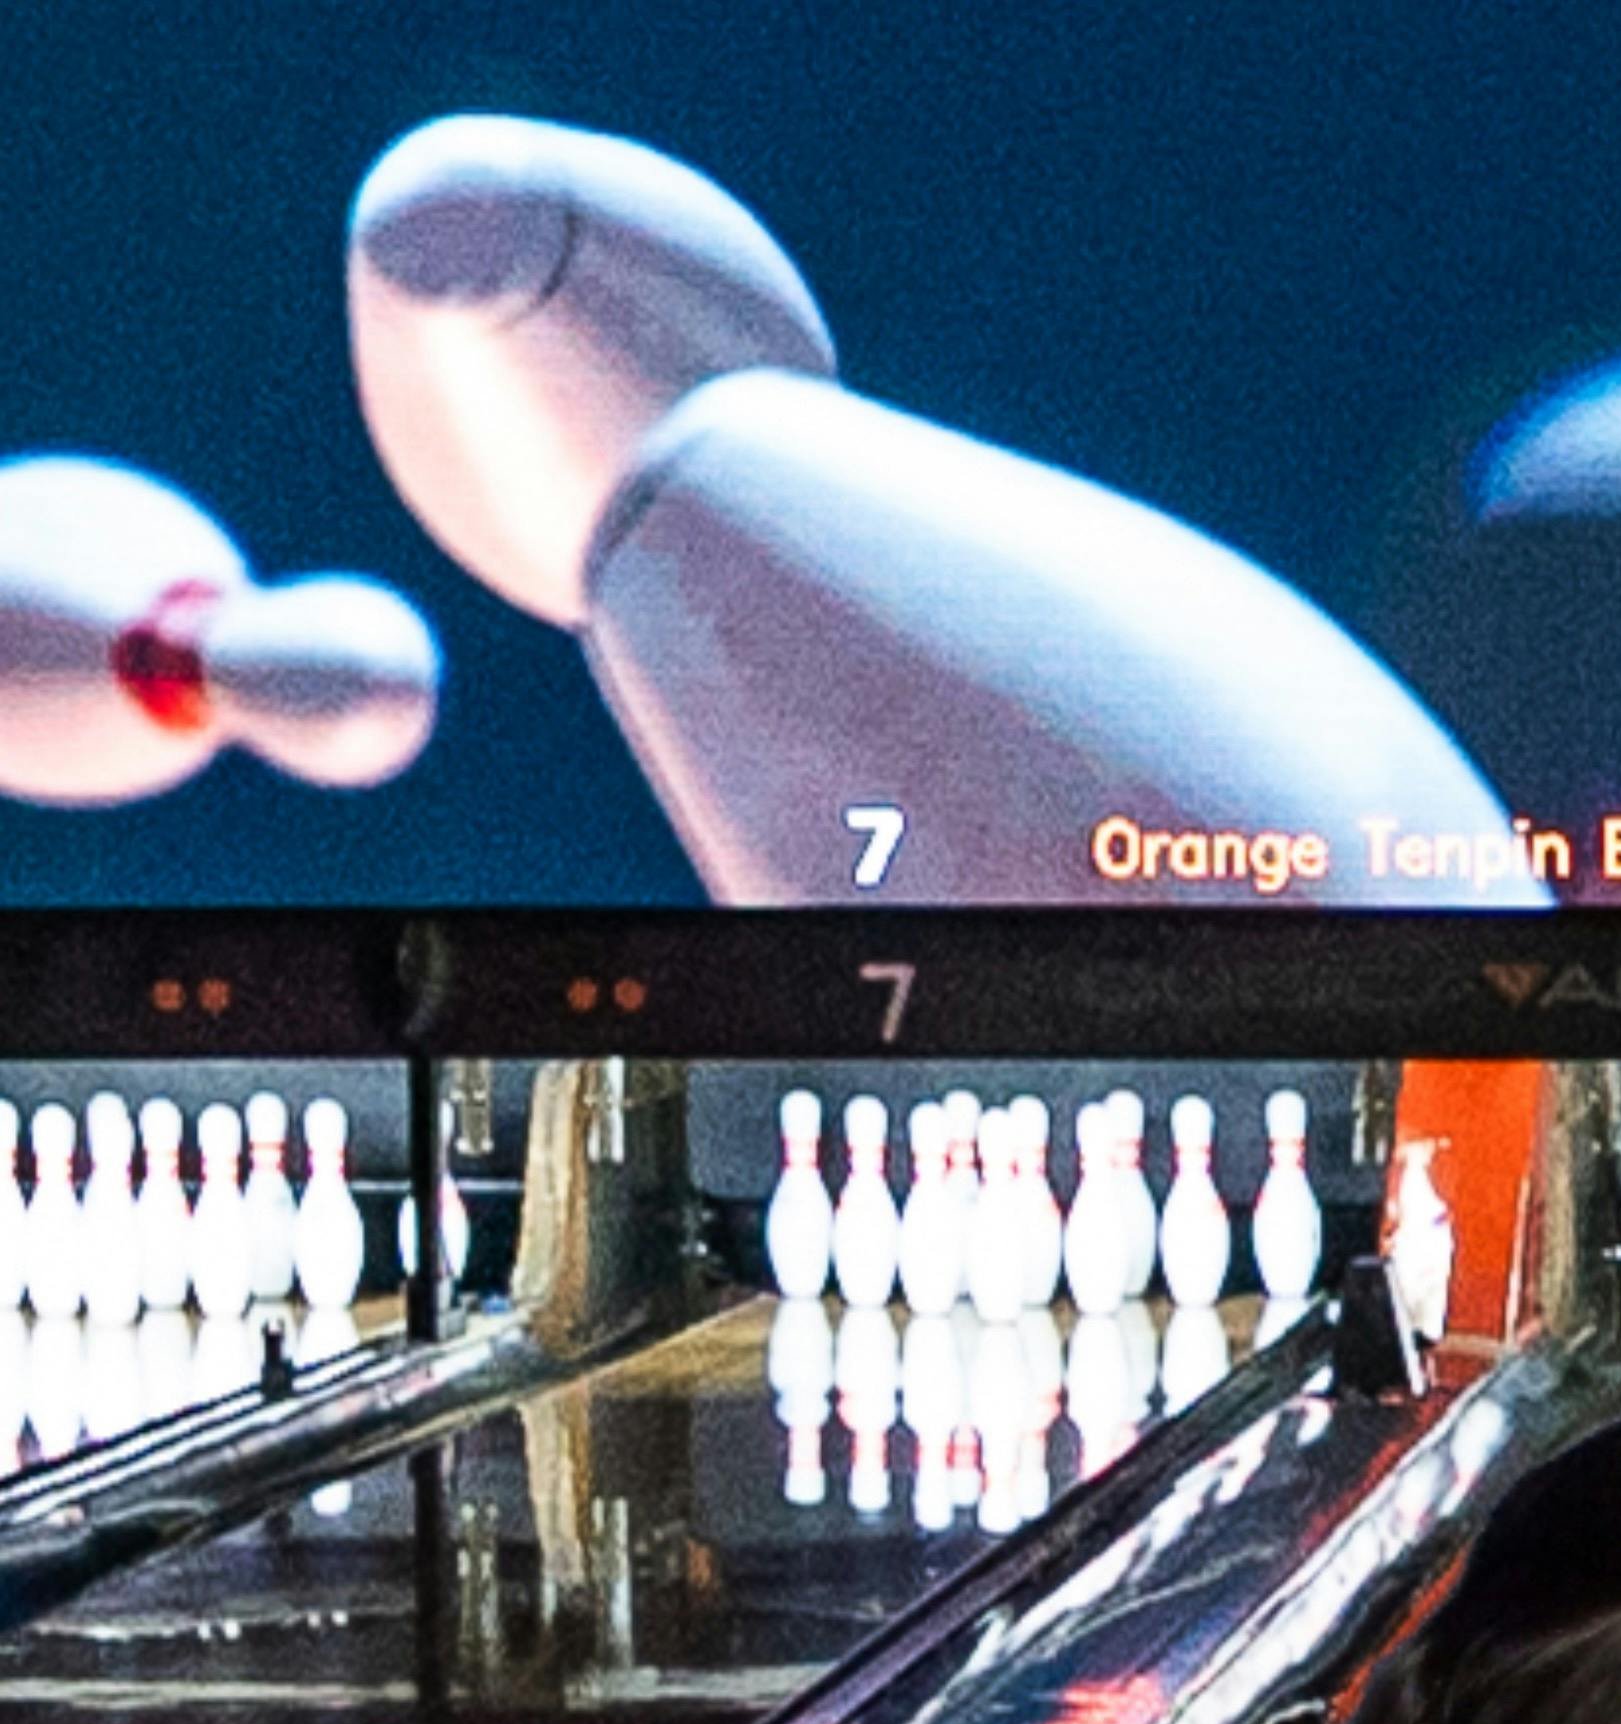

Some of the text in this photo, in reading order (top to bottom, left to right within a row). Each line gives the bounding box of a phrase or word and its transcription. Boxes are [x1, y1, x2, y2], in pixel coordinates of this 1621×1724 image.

[847, 808, 905, 885] 7
[1092, 816, 1328, 892] Orange
[1360, 817, 1571, 891] Tenpin
[858, 962, 917, 1042] 7
